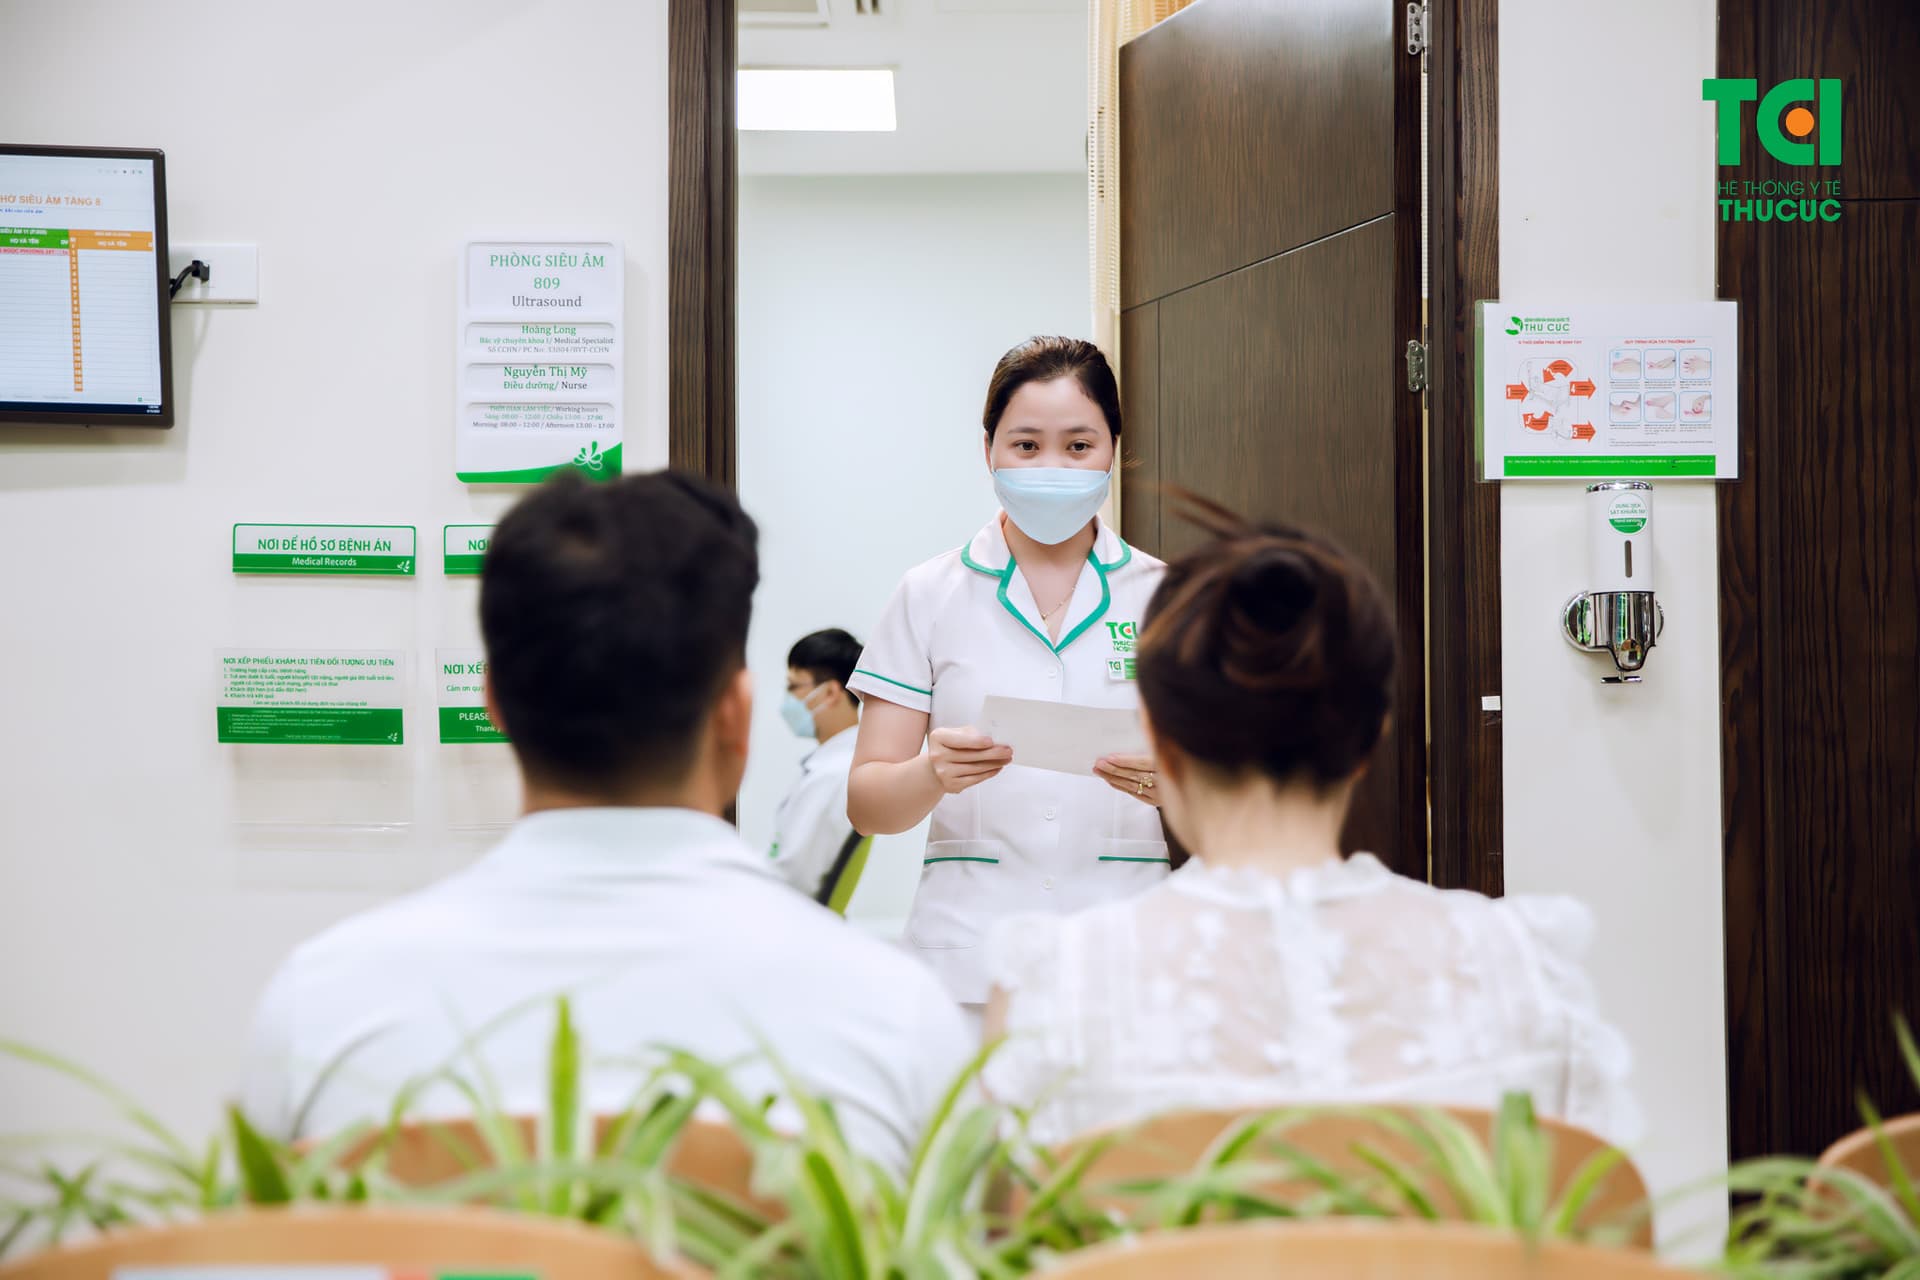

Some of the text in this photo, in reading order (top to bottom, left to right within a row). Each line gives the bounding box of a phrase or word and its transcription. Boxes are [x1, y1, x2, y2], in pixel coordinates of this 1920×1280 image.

[490, 251, 604, 267] PHÒNG SIÊU ÂM
[533, 277, 560, 289] 809
[512, 296, 582, 307] Ultrasound
[553, 325, 576, 336] Long
[504, 364, 588, 379] Nguyễn Thị Mỹ
[258, 538, 279, 550] NƠI
[282, 534, 297, 550] ĐỂ
[320, 538, 336, 550] SƠ
[339, 538, 370, 552] BỆNH
[374, 537, 391, 551] ÁN
[292, 557, 357, 567] Medical Records
[1105, 622, 1136, 639] TCI
[444, 664, 463, 674] NƠI
